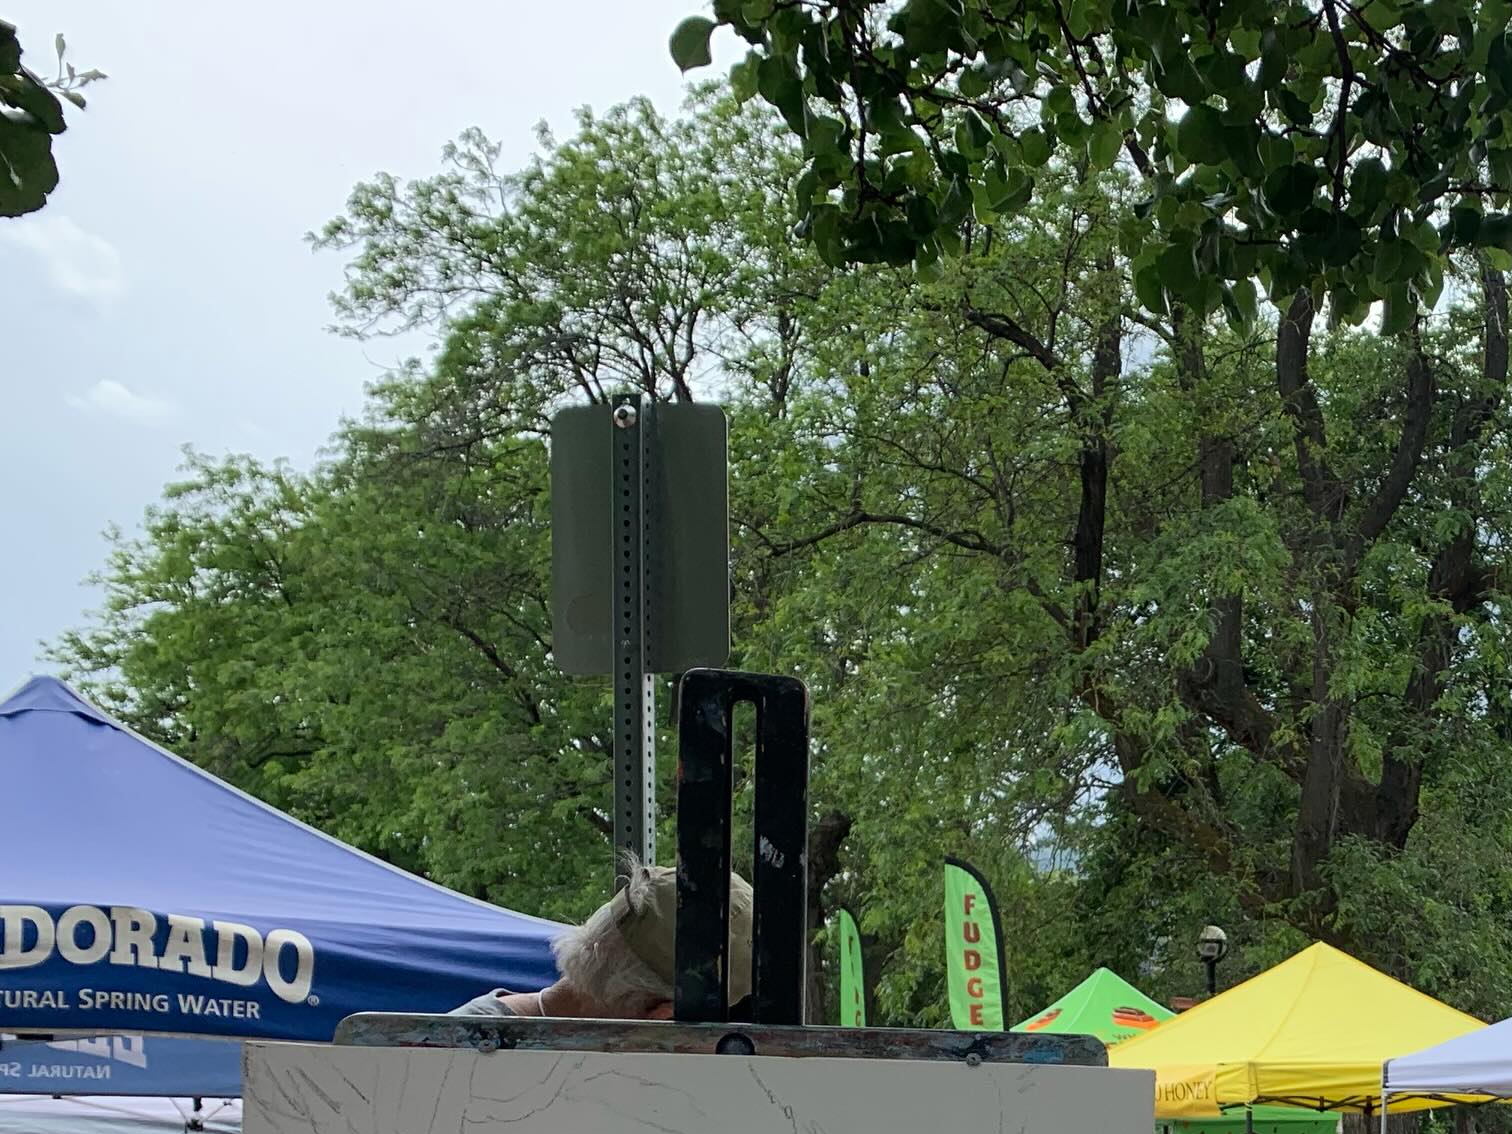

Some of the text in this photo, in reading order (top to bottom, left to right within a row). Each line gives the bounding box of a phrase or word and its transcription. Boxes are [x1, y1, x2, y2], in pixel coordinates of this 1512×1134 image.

[963, 894, 984, 1026] FUDGE
[0, 987, 260, 1019] URAL SPRING WATER
[1165, 1081, 1212, 1102] HONEY
